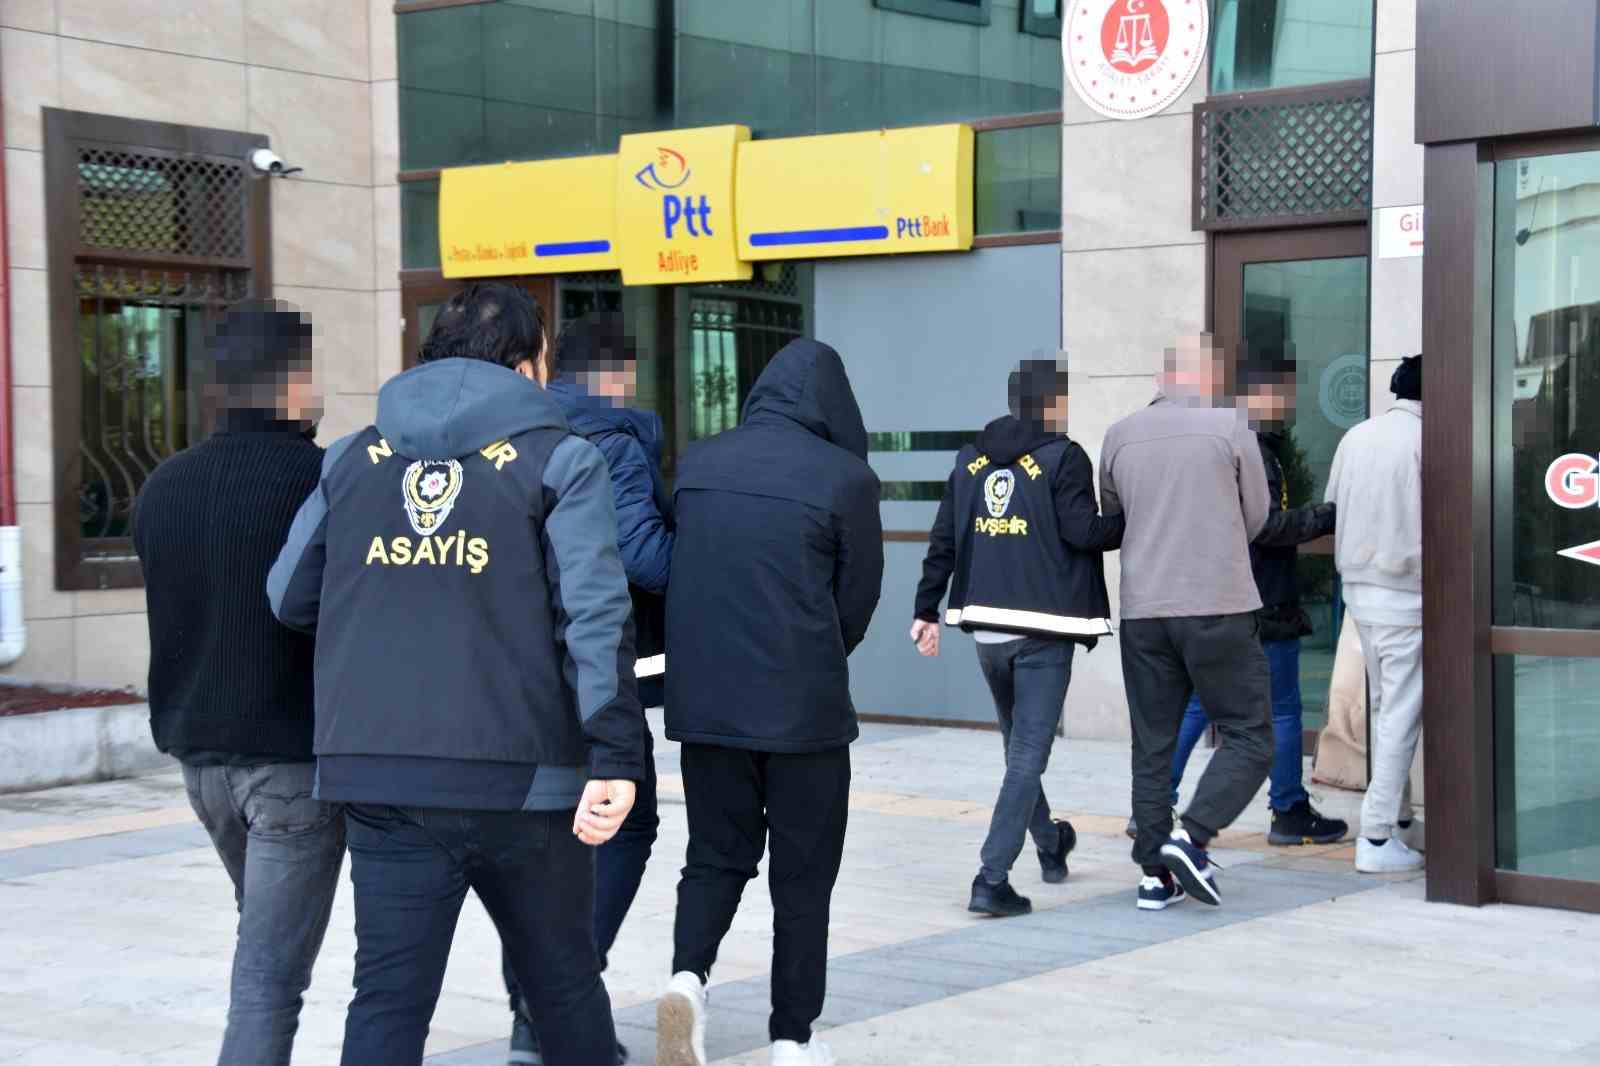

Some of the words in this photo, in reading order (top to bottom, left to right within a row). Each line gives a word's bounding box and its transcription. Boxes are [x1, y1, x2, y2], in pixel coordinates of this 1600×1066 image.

[662, 193, 713, 239] Ptt
[896, 212, 950, 239] PttBank
[657, 248, 700, 276] Adliye
[1545, 452, 1600, 509] G
[365, 529, 489, 574] ASAYİŞ
